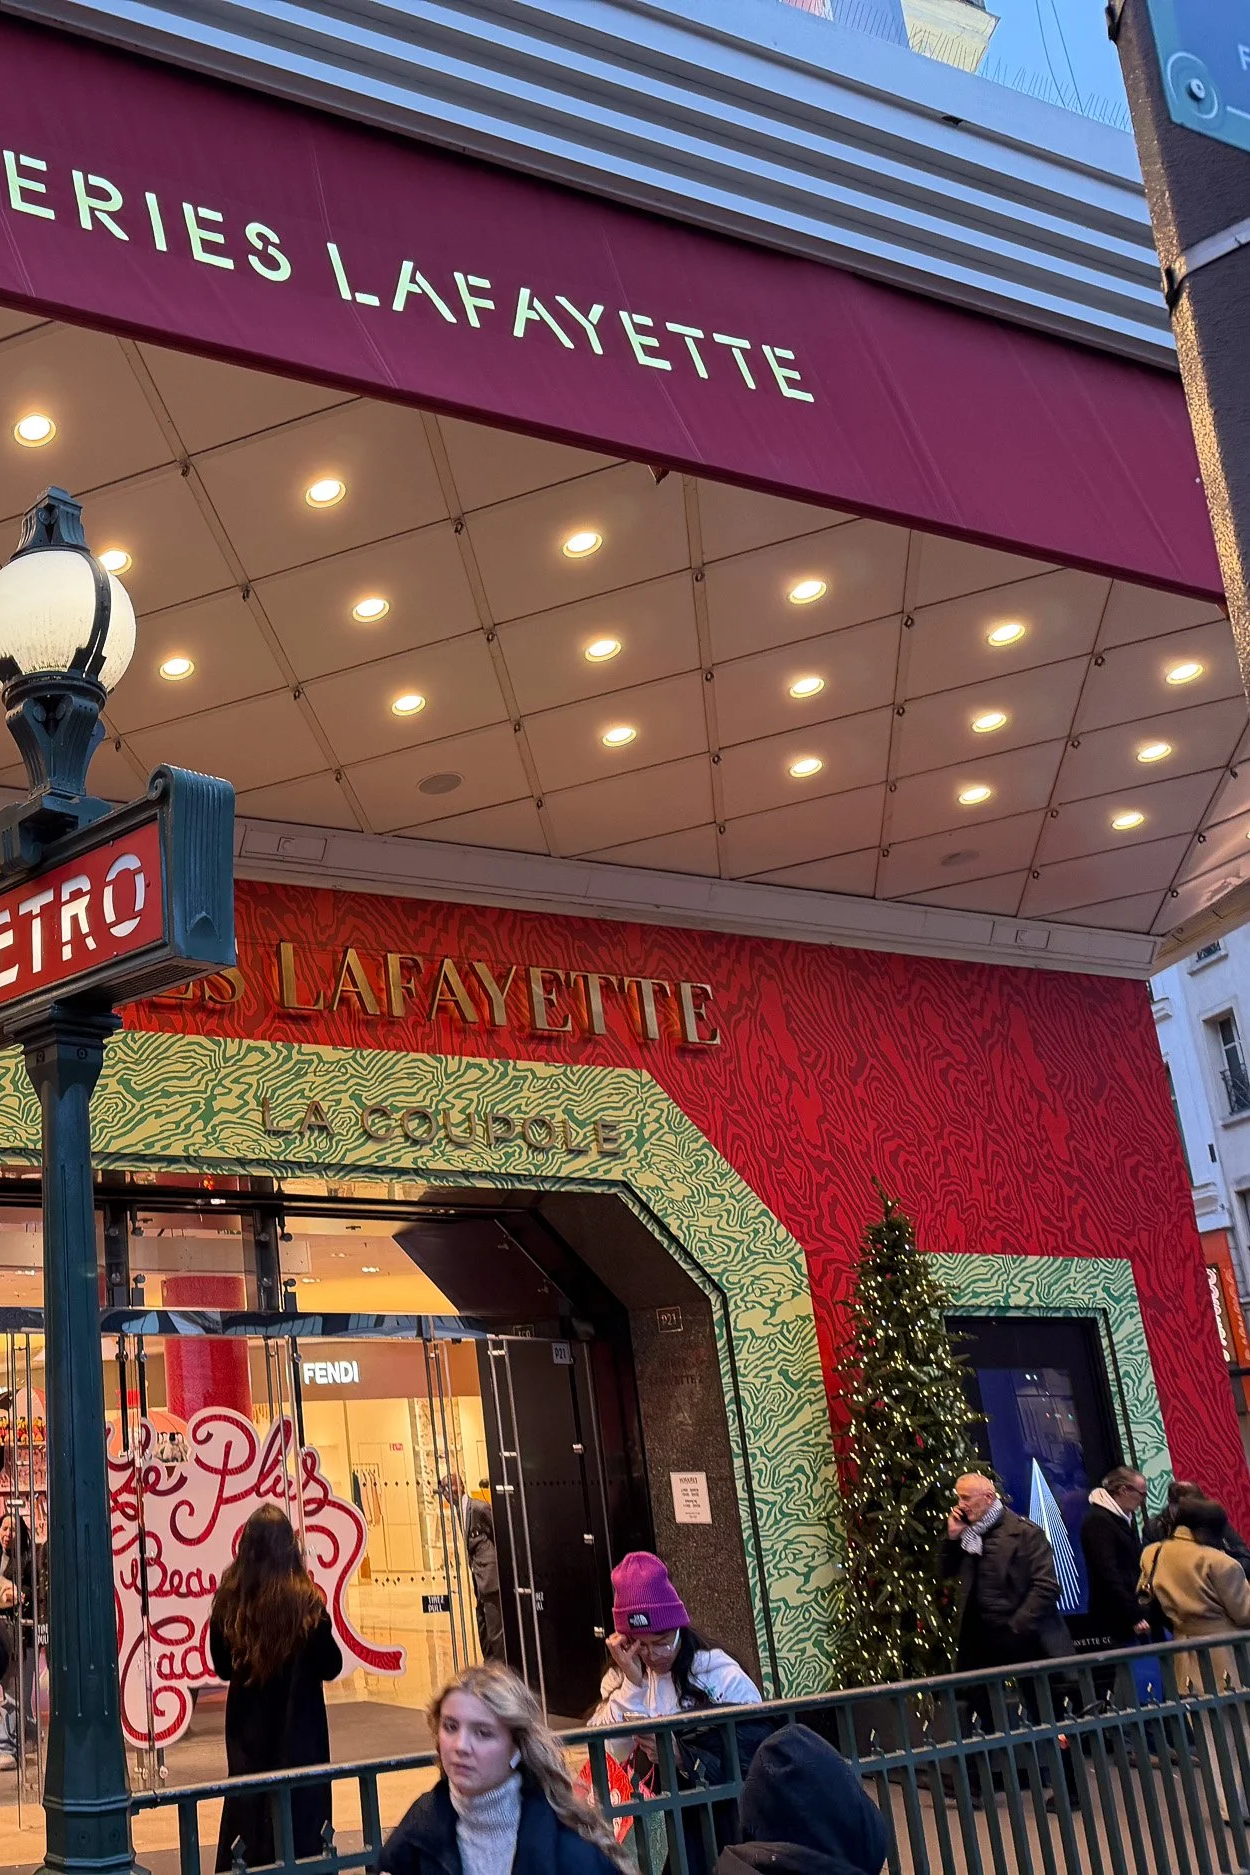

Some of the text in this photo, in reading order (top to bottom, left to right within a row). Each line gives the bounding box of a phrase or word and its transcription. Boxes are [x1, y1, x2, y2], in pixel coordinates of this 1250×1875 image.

[327, 241, 816, 404] LAFAYETTE
[275, 940, 722, 1047] LAFAYETTE
[261, 1099, 622, 1156] LA COUPOLE
[303, 1360, 360, 1385] FENDI
[169, 1413, 332, 1547] Plus
